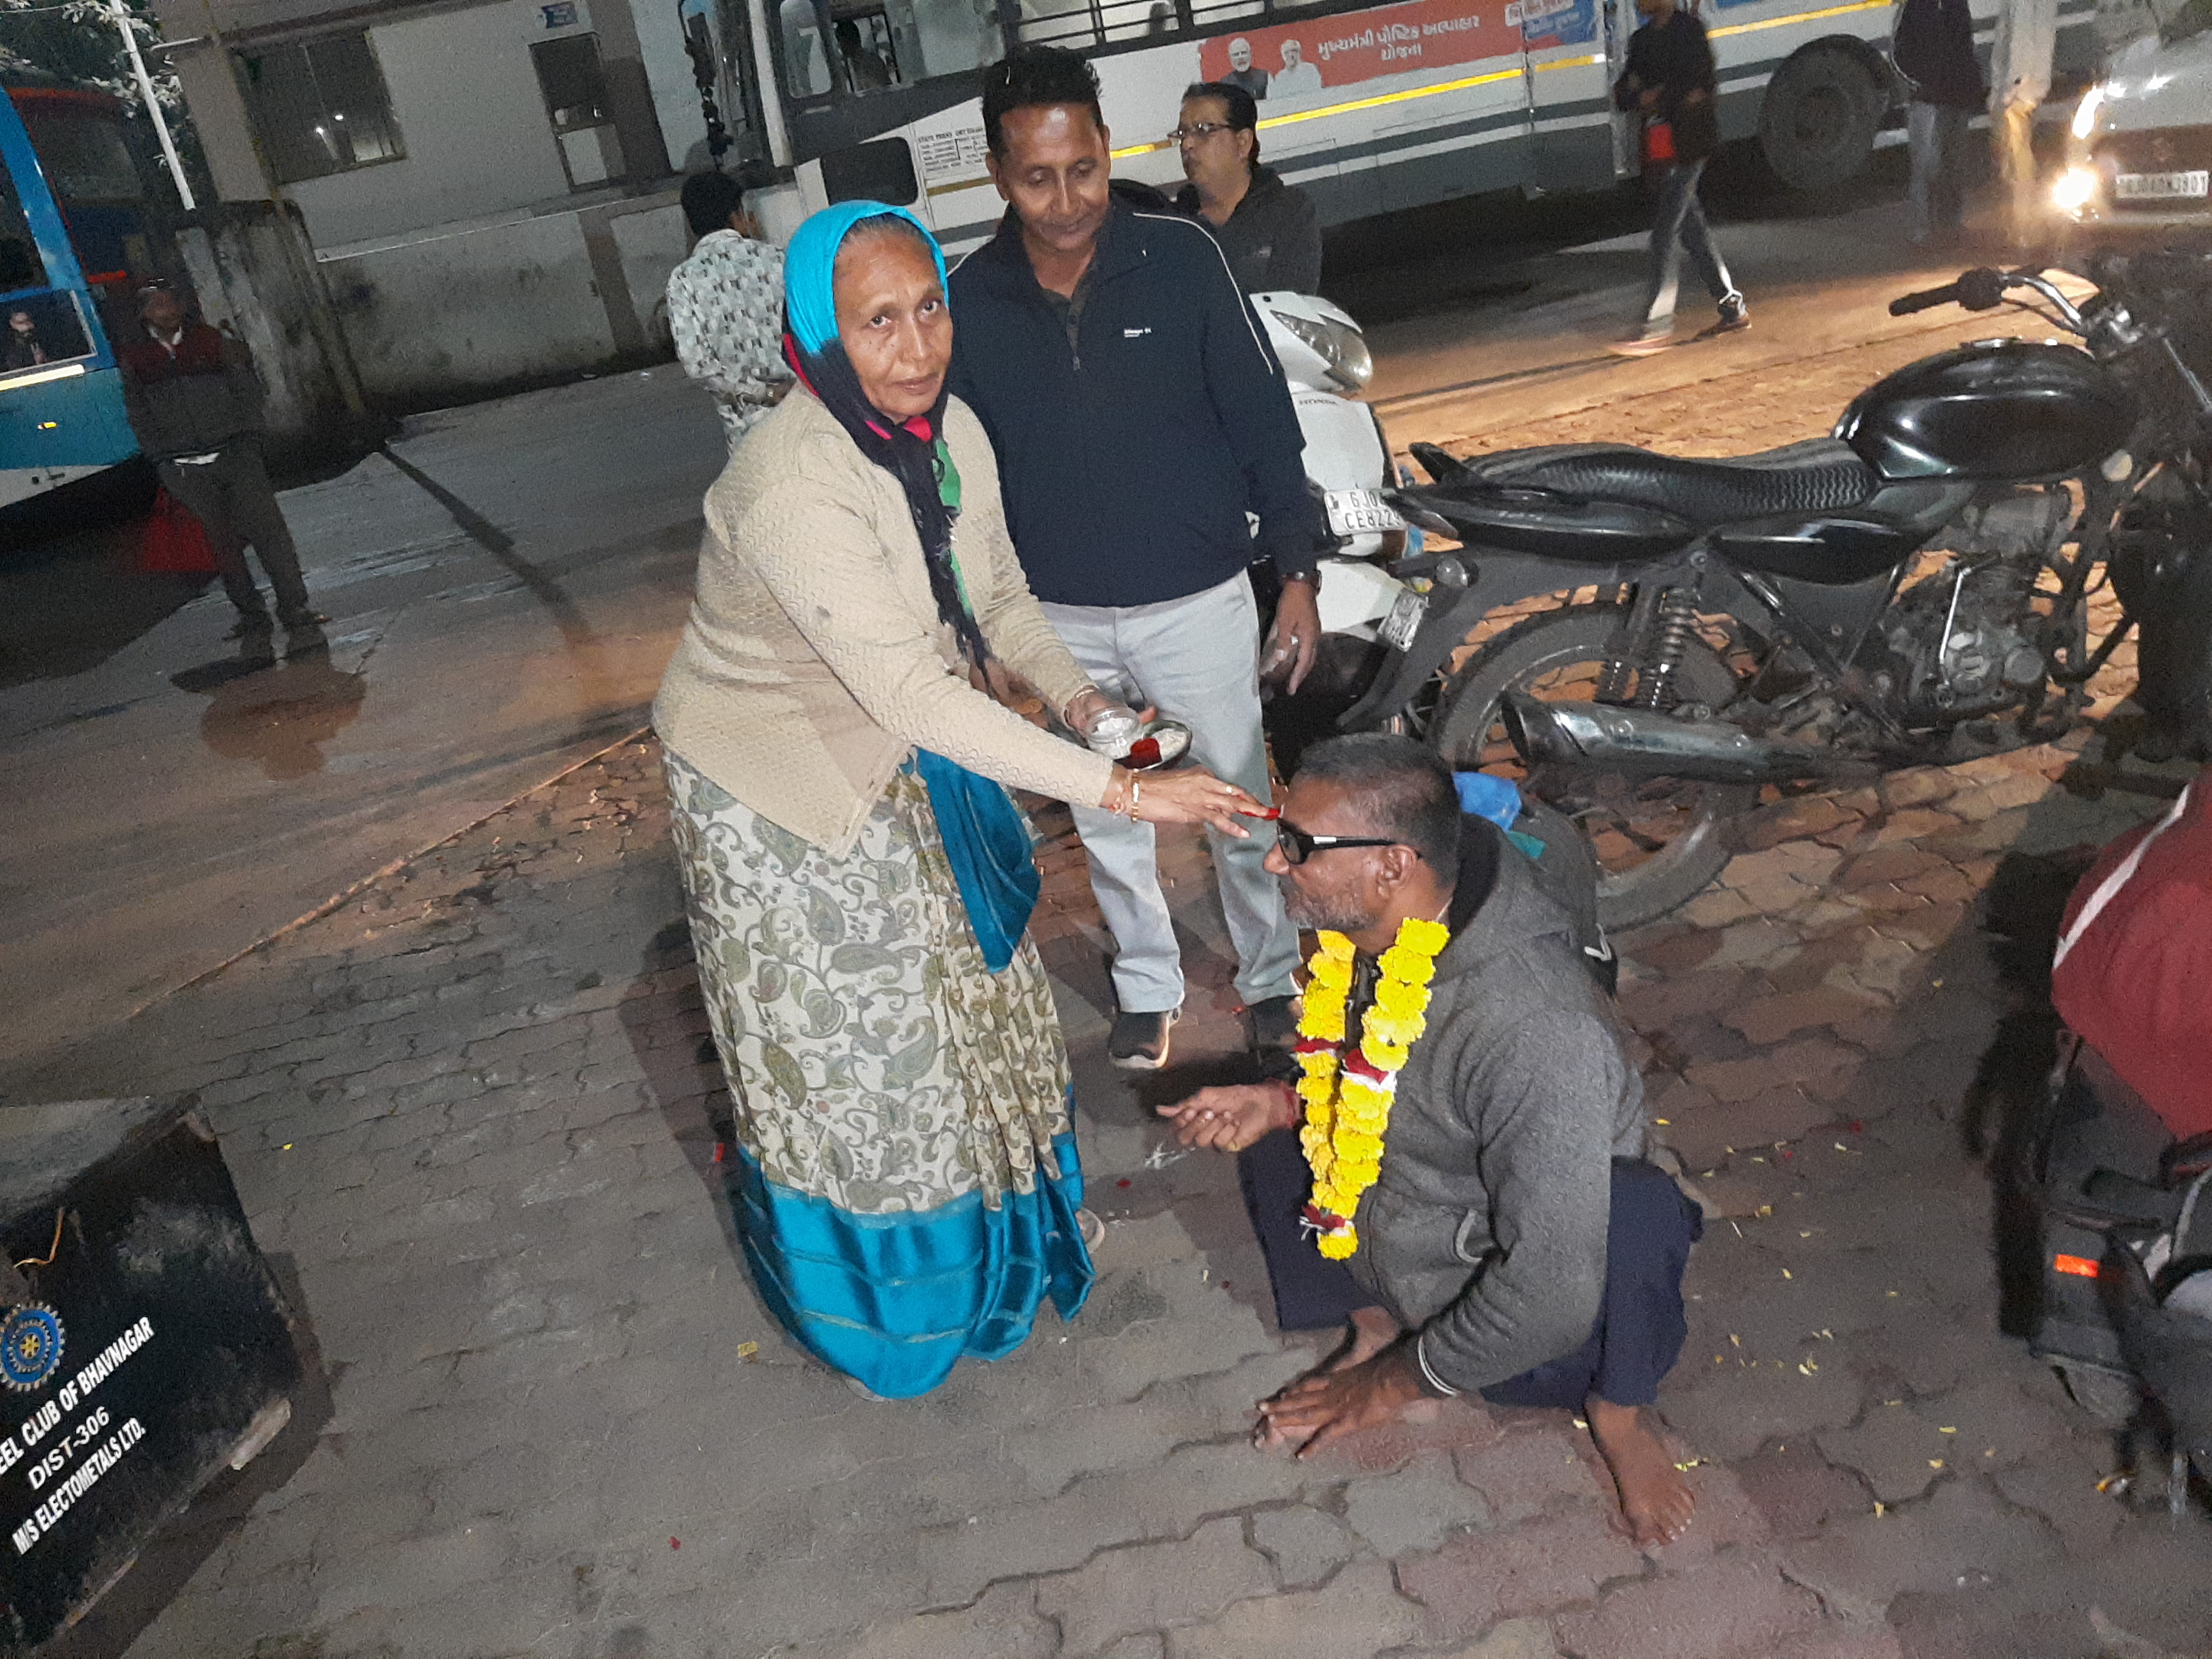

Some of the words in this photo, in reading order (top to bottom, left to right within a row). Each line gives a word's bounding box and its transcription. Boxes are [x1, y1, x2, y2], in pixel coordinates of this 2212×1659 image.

[22, 1400, 61, 1447] CLUB
[59, 1379, 79, 1411] OF
[77, 1316, 154, 1396] BHAVNAGAR
[12, 1518, 39, 1555] M/S
[35, 1436, 122, 1532] ELECTOMETALS
[118, 1417, 147, 1451] LTD.
[28, 1406, 110, 1490] DIST-306
